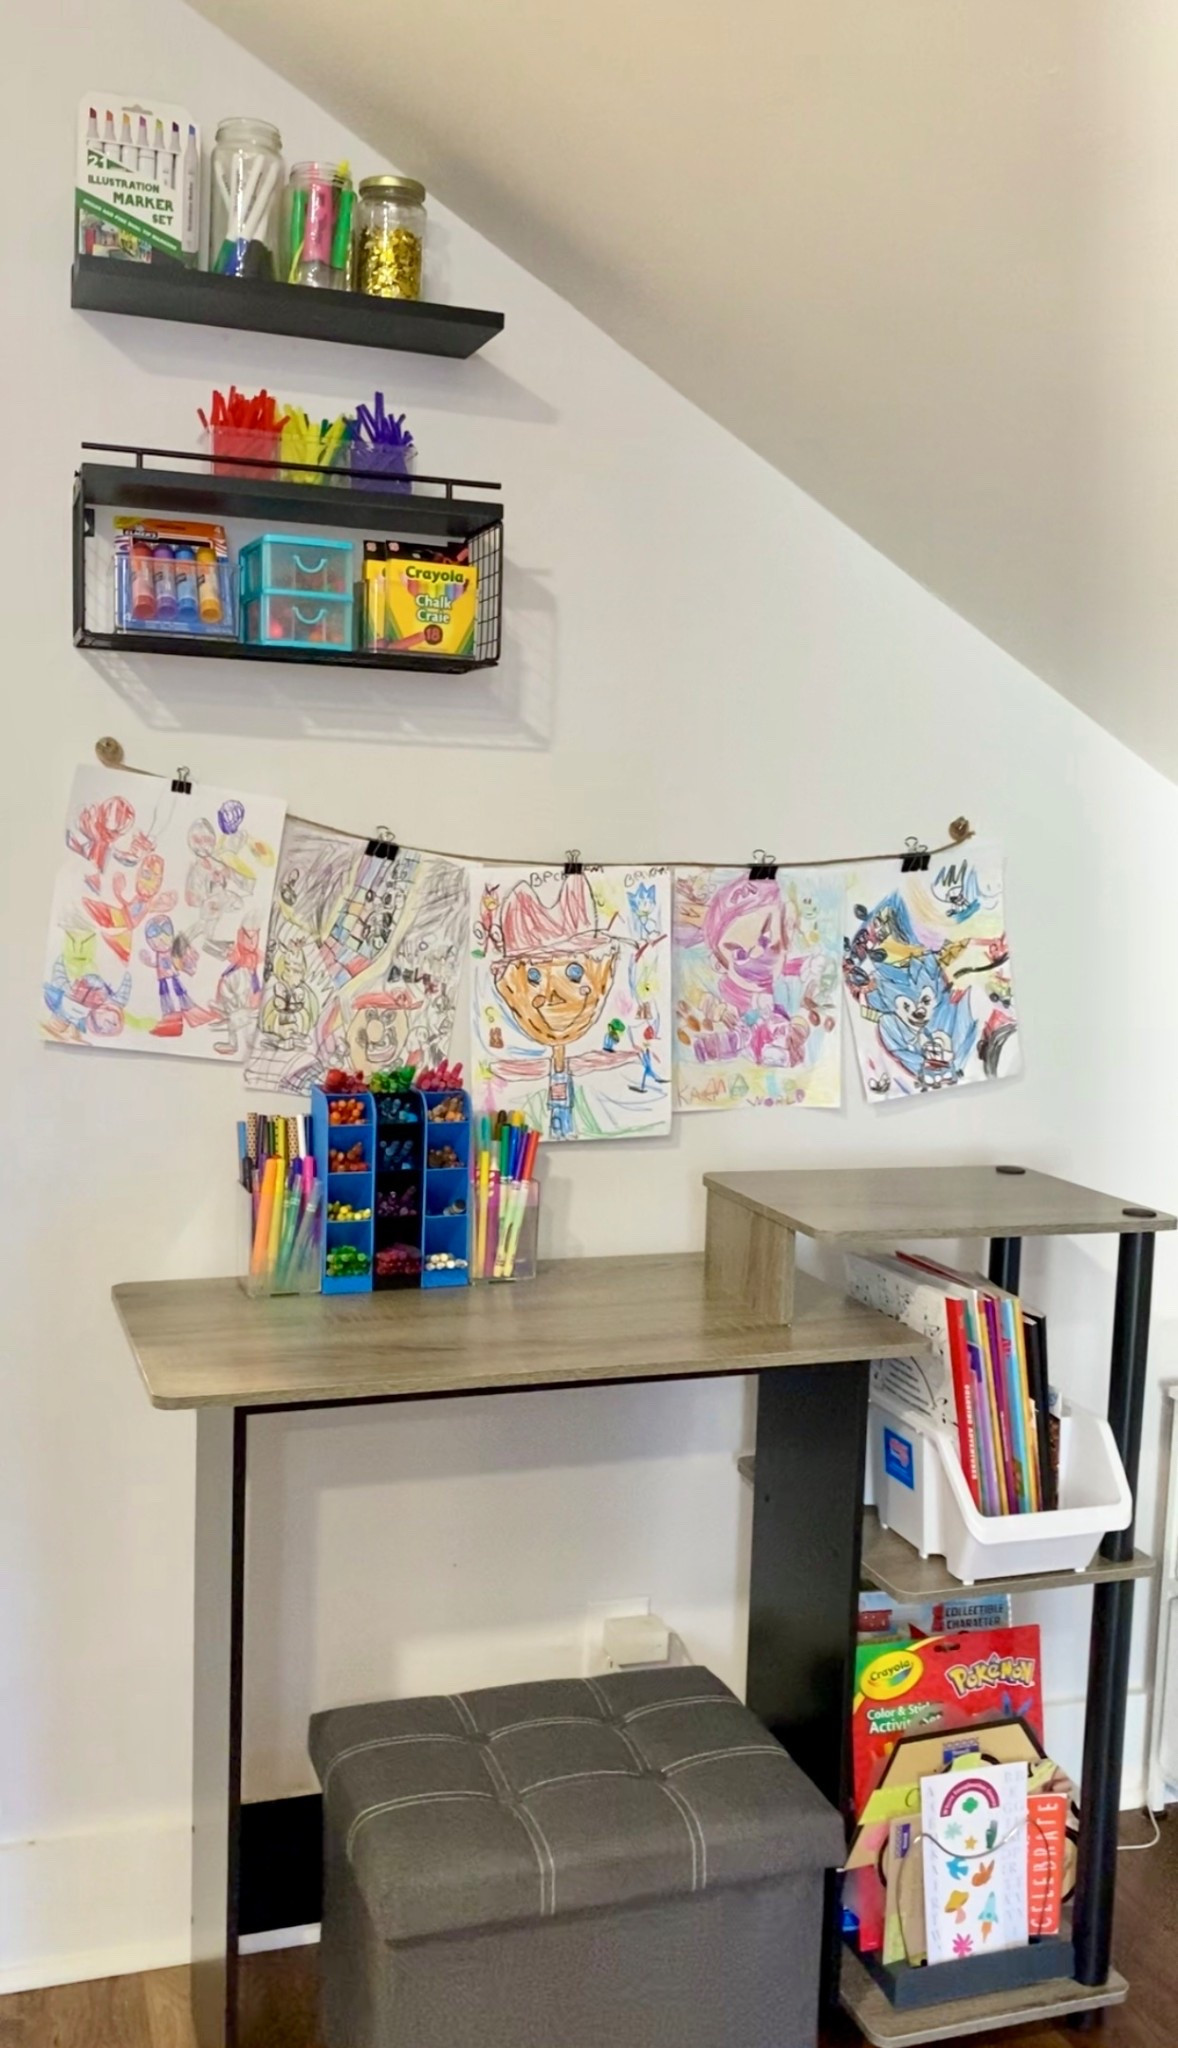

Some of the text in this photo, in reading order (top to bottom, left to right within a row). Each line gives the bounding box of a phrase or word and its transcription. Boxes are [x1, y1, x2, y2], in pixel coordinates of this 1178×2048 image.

[87, 174, 160, 194] ILLUSTRATION
[112, 191, 175, 213] MARKER
[151, 213, 174, 226] SET
[405, 565, 465, 584] Crayola
[415, 594, 452, 610] Chalk
[417, 609, 450, 623] Craie
[945, 1603, 1004, 1617] COLLECTIBLE
[946, 1616, 1001, 1630] CHARACTER
[869, 1660, 911, 1681] Crayola
[867, 1707, 895, 1721] Color
[897, 1705, 906, 1717] &
[1030, 1802, 1059, 1928] CELEBRATE
